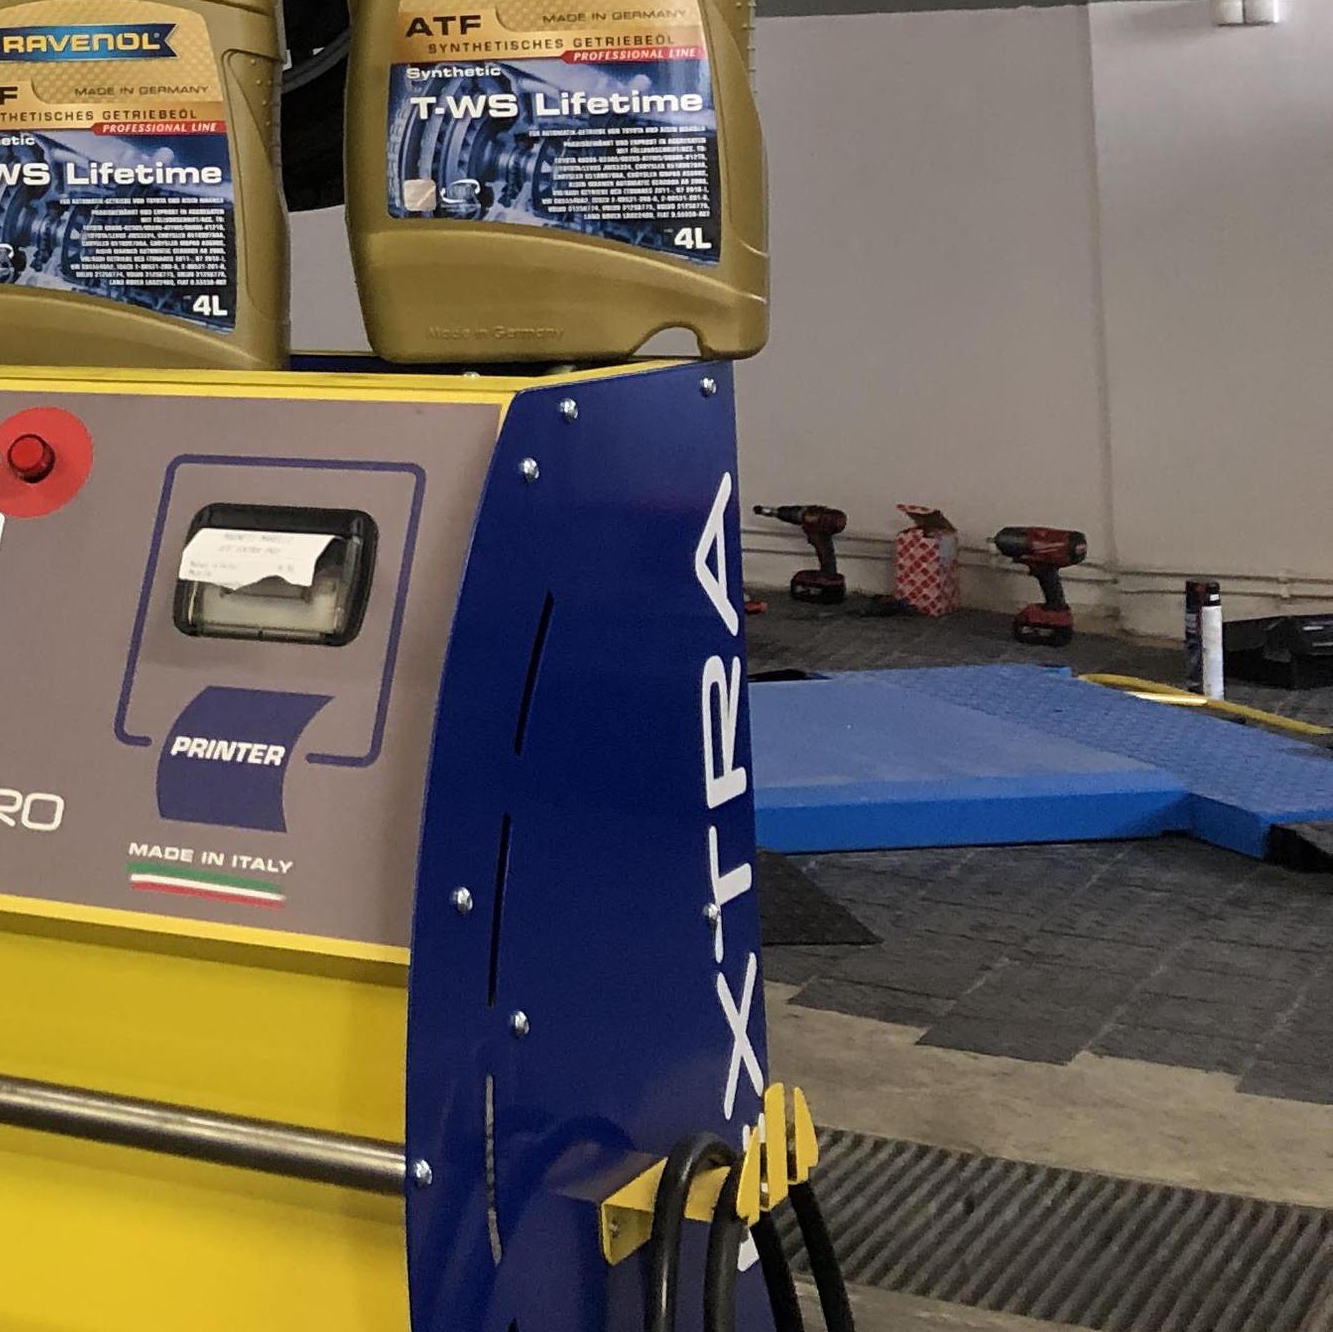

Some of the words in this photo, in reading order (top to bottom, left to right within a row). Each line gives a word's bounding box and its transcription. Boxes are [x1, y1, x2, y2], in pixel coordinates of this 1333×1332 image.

[405, 15, 482, 38] ATF
[542, 13, 588, 24] MADE
[591, 12, 607, 22] IN
[612, 9, 687, 22] GERMANY
[2, 31, 161, 54] RAVENOL
[428, 38, 564, 54] SYNTHETISCHES
[573, 49, 664, 61] PROFESSIONAL
[667, 48, 696, 59] LINE
[406, 65, 502, 80] Synthetic
[74, 86, 115, 96] MADE
[119, 86, 135, 95] IN
[138, 84, 209, 95] GERMANY
[410, 94, 518, 120] T-WS
[535, 89, 705, 115] Lifetime
[102, 122, 188, 134] PROFESSIONAL
[191, 121, 217, 132] LINE
[66, 161, 222, 185] Lifetime
[673, 227, 712, 250] 4L
[192, 294, 228, 316] 4L
[170, 735, 287, 766] PRINTER
[694, 471, 769, 1196] XTRA
[128, 841, 195, 863] MADE
[201, 851, 225, 866] IN
[232, 854, 294, 874] ITALY
